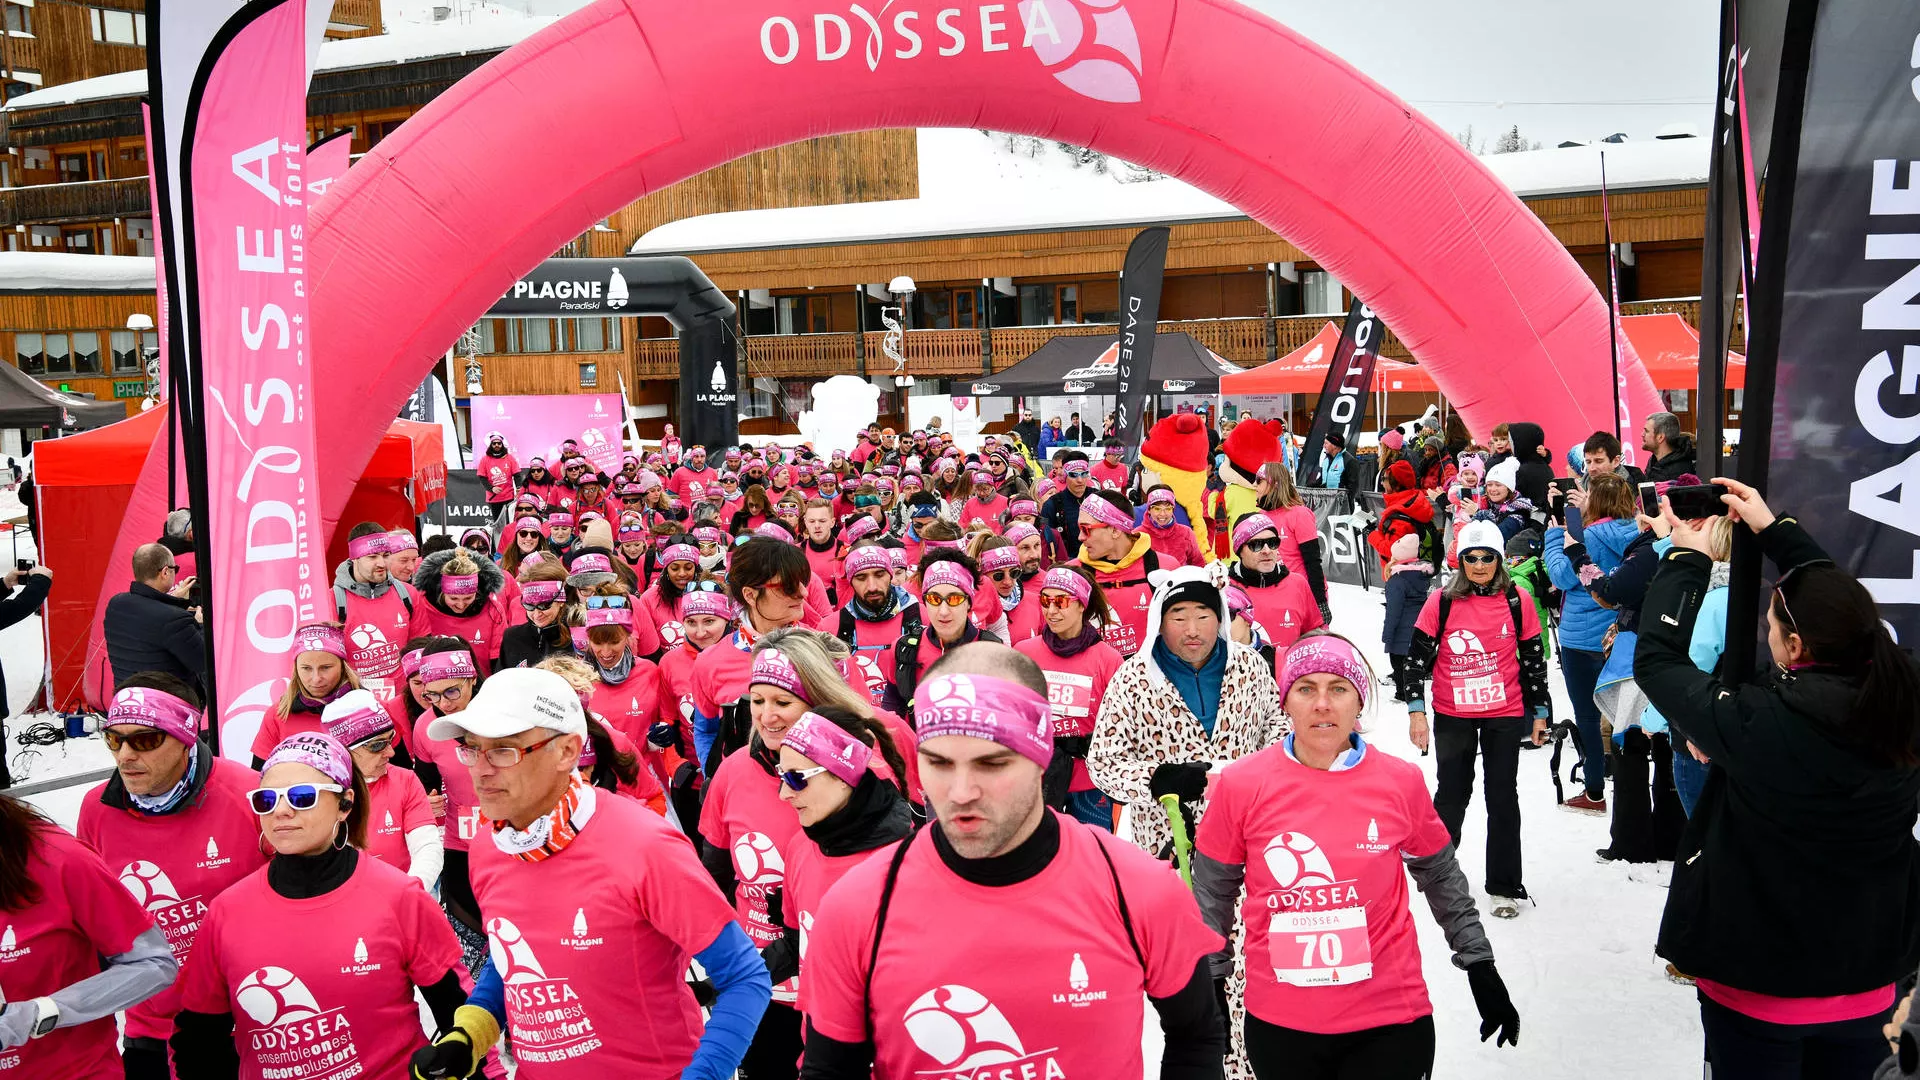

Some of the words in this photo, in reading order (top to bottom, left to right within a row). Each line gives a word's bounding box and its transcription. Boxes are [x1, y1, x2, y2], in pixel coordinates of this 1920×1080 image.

[760, 0, 1060, 72] ODYSSEA
[282, 142, 303, 207] fort
[289, 224, 305, 298] plus
[513, 281, 601, 299] PLAGNE
[560, 301, 600, 310] Paradiski
[209, 137, 303, 654] ODYSSEA
[696, 394, 707, 402] LA
[708, 394, 736, 402] PLAGNE
[448, 506, 462, 516] LA
[464, 506, 492, 516] PLAG
[296, 477, 314, 622] nsemble
[1105, 628, 1136, 640] SSEA
[353, 644, 399, 660] ODYSSEA
[1457, 685, 1503, 703] 1152
[916, 708, 998, 728] ODYSSEA
[206, 857, 231, 867] PLAGNE
[1266, 886, 1359, 910] ODYSSEA
[157, 900, 208, 926] SSEA
[1292, 916, 1340, 926] ODYSSEA
[571, 938, 603, 946] PLAGNE
[746, 925, 755, 936] LA
[755, 928, 778, 940] COURSE
[0, 946, 31, 960] PLAGNE
[1296, 933, 1343, 967] 70
[352, 964, 381, 972] PLAGNE
[506, 983, 579, 1012] DYSSEA
[1053, 994, 1066, 1003] LA
[1068, 991, 1107, 1002] PLAGNE
[252, 1014, 350, 1050] ODYSSEA
[258, 1030, 352, 1064] ensembleonest
[523, 1050, 549, 1062] COURSE
[550, 1049, 568, 1062] DES
[568, 1038, 602, 1059] NEIGES
[262, 1043, 357, 1080] encoreplusfort
